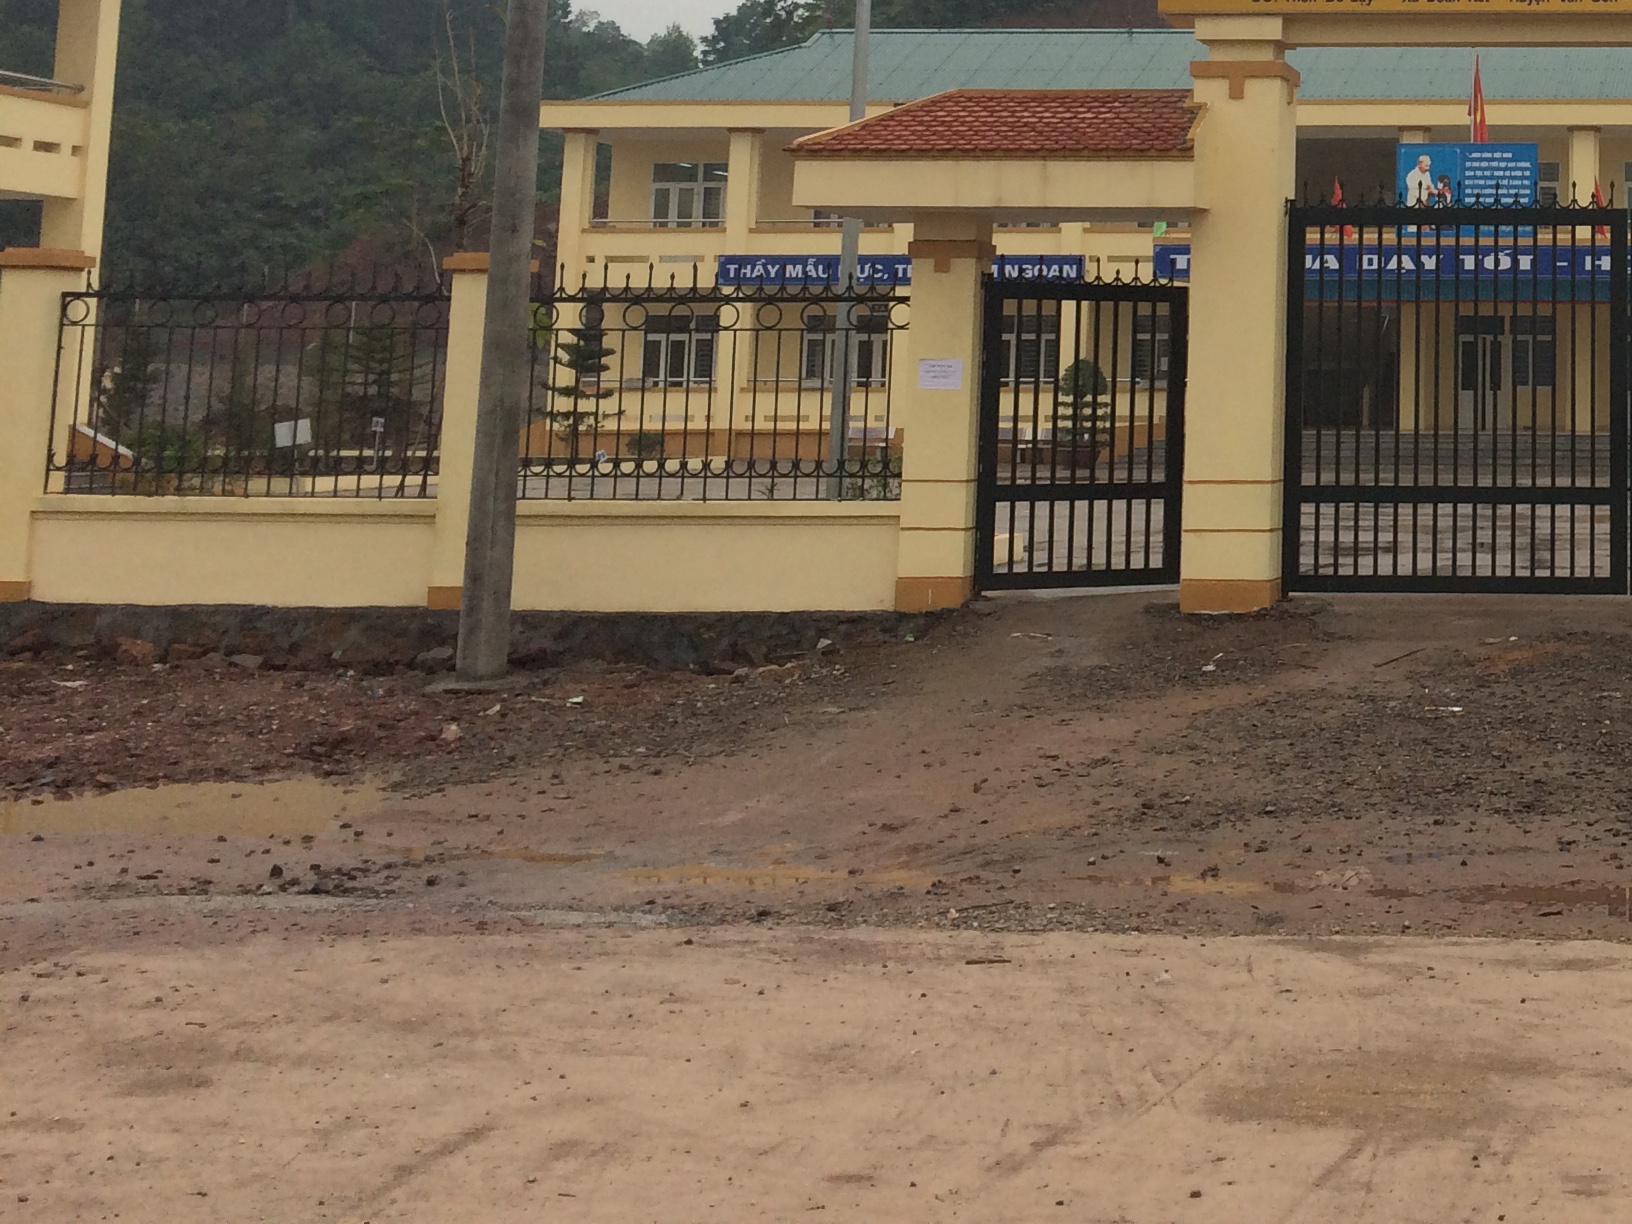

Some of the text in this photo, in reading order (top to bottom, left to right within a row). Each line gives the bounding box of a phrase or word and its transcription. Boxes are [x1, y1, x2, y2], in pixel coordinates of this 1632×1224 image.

[726, 259, 780, 278] THẦY
[785, 258, 833, 278] MẪU
[1357, 255, 1443, 273] DẠY
[1460, 250, 1535, 270] TỐT
